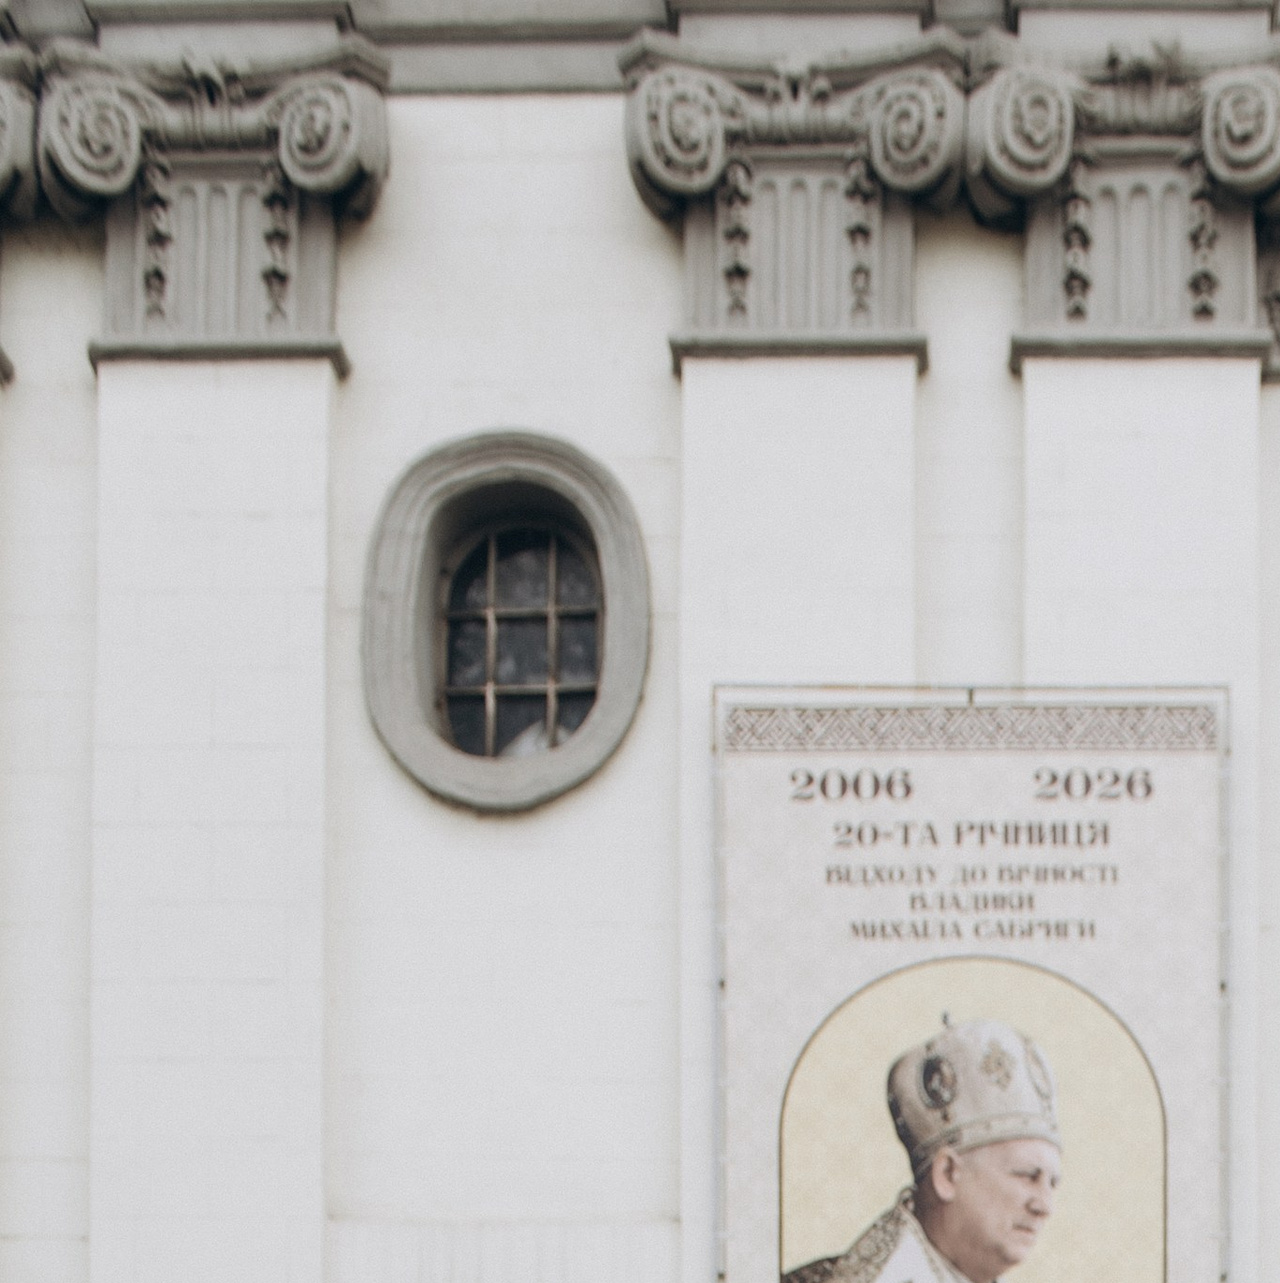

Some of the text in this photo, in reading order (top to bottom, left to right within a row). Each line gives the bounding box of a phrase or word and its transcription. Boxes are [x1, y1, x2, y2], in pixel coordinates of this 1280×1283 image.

[789, 768, 914, 803] 2006
[1033, 768, 1154, 803] 2026
[833, 820, 1111, 850] 20-ТА РІЧНИЦЯ
[825, 863, 938, 887] ВІДХОДУ
[952, 863, 988, 887] ДО
